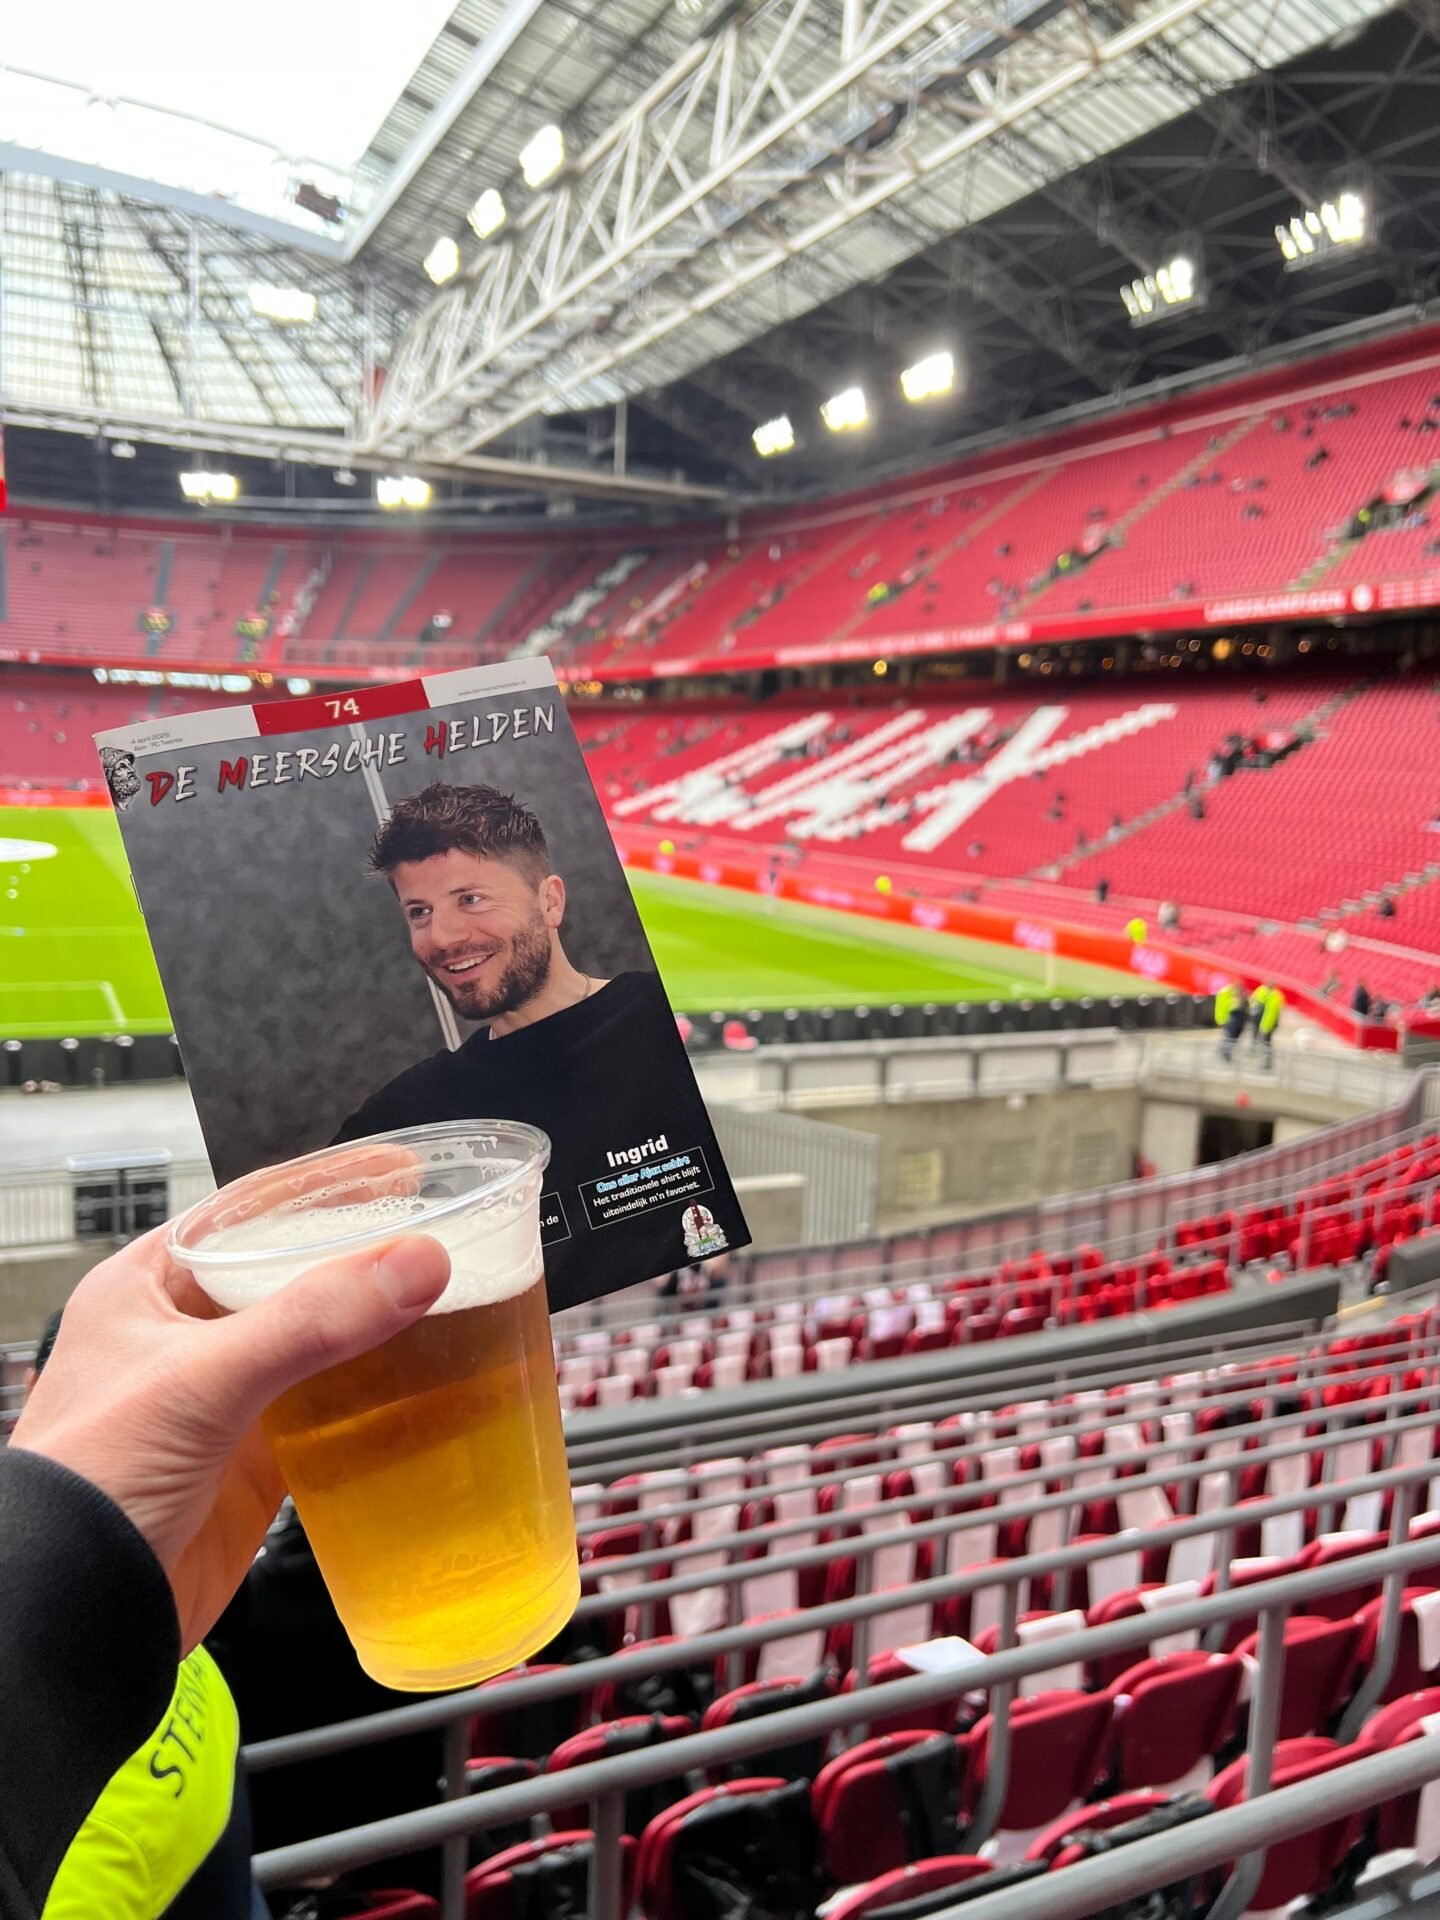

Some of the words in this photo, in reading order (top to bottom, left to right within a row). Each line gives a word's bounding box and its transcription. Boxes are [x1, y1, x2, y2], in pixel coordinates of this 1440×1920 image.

[325, 698, 360, 719] 74
[145, 766, 198, 806] DE
[218, 733, 407, 793] MEERSCHE
[424, 704, 554, 760] HELDEN
[606, 1134, 669, 1168] Ingrid
[593, 1195, 610, 1207] Het
[611, 1180, 660, 1201] traditionele
[660, 1172, 681, 1185] shirt
[681, 1165, 701, 1179] blijft
[596, 1180, 617, 1193] Ons
[617, 1172, 640, 1186] aller
[640, 1166, 662, 1179] Ajax
[603, 1198, 648, 1218] uiteindelijk
[649, 1193, 665, 1204] m'n
[666, 1181, 700, 1197] favoriet.
[546, 1215, 559, 1225] de
